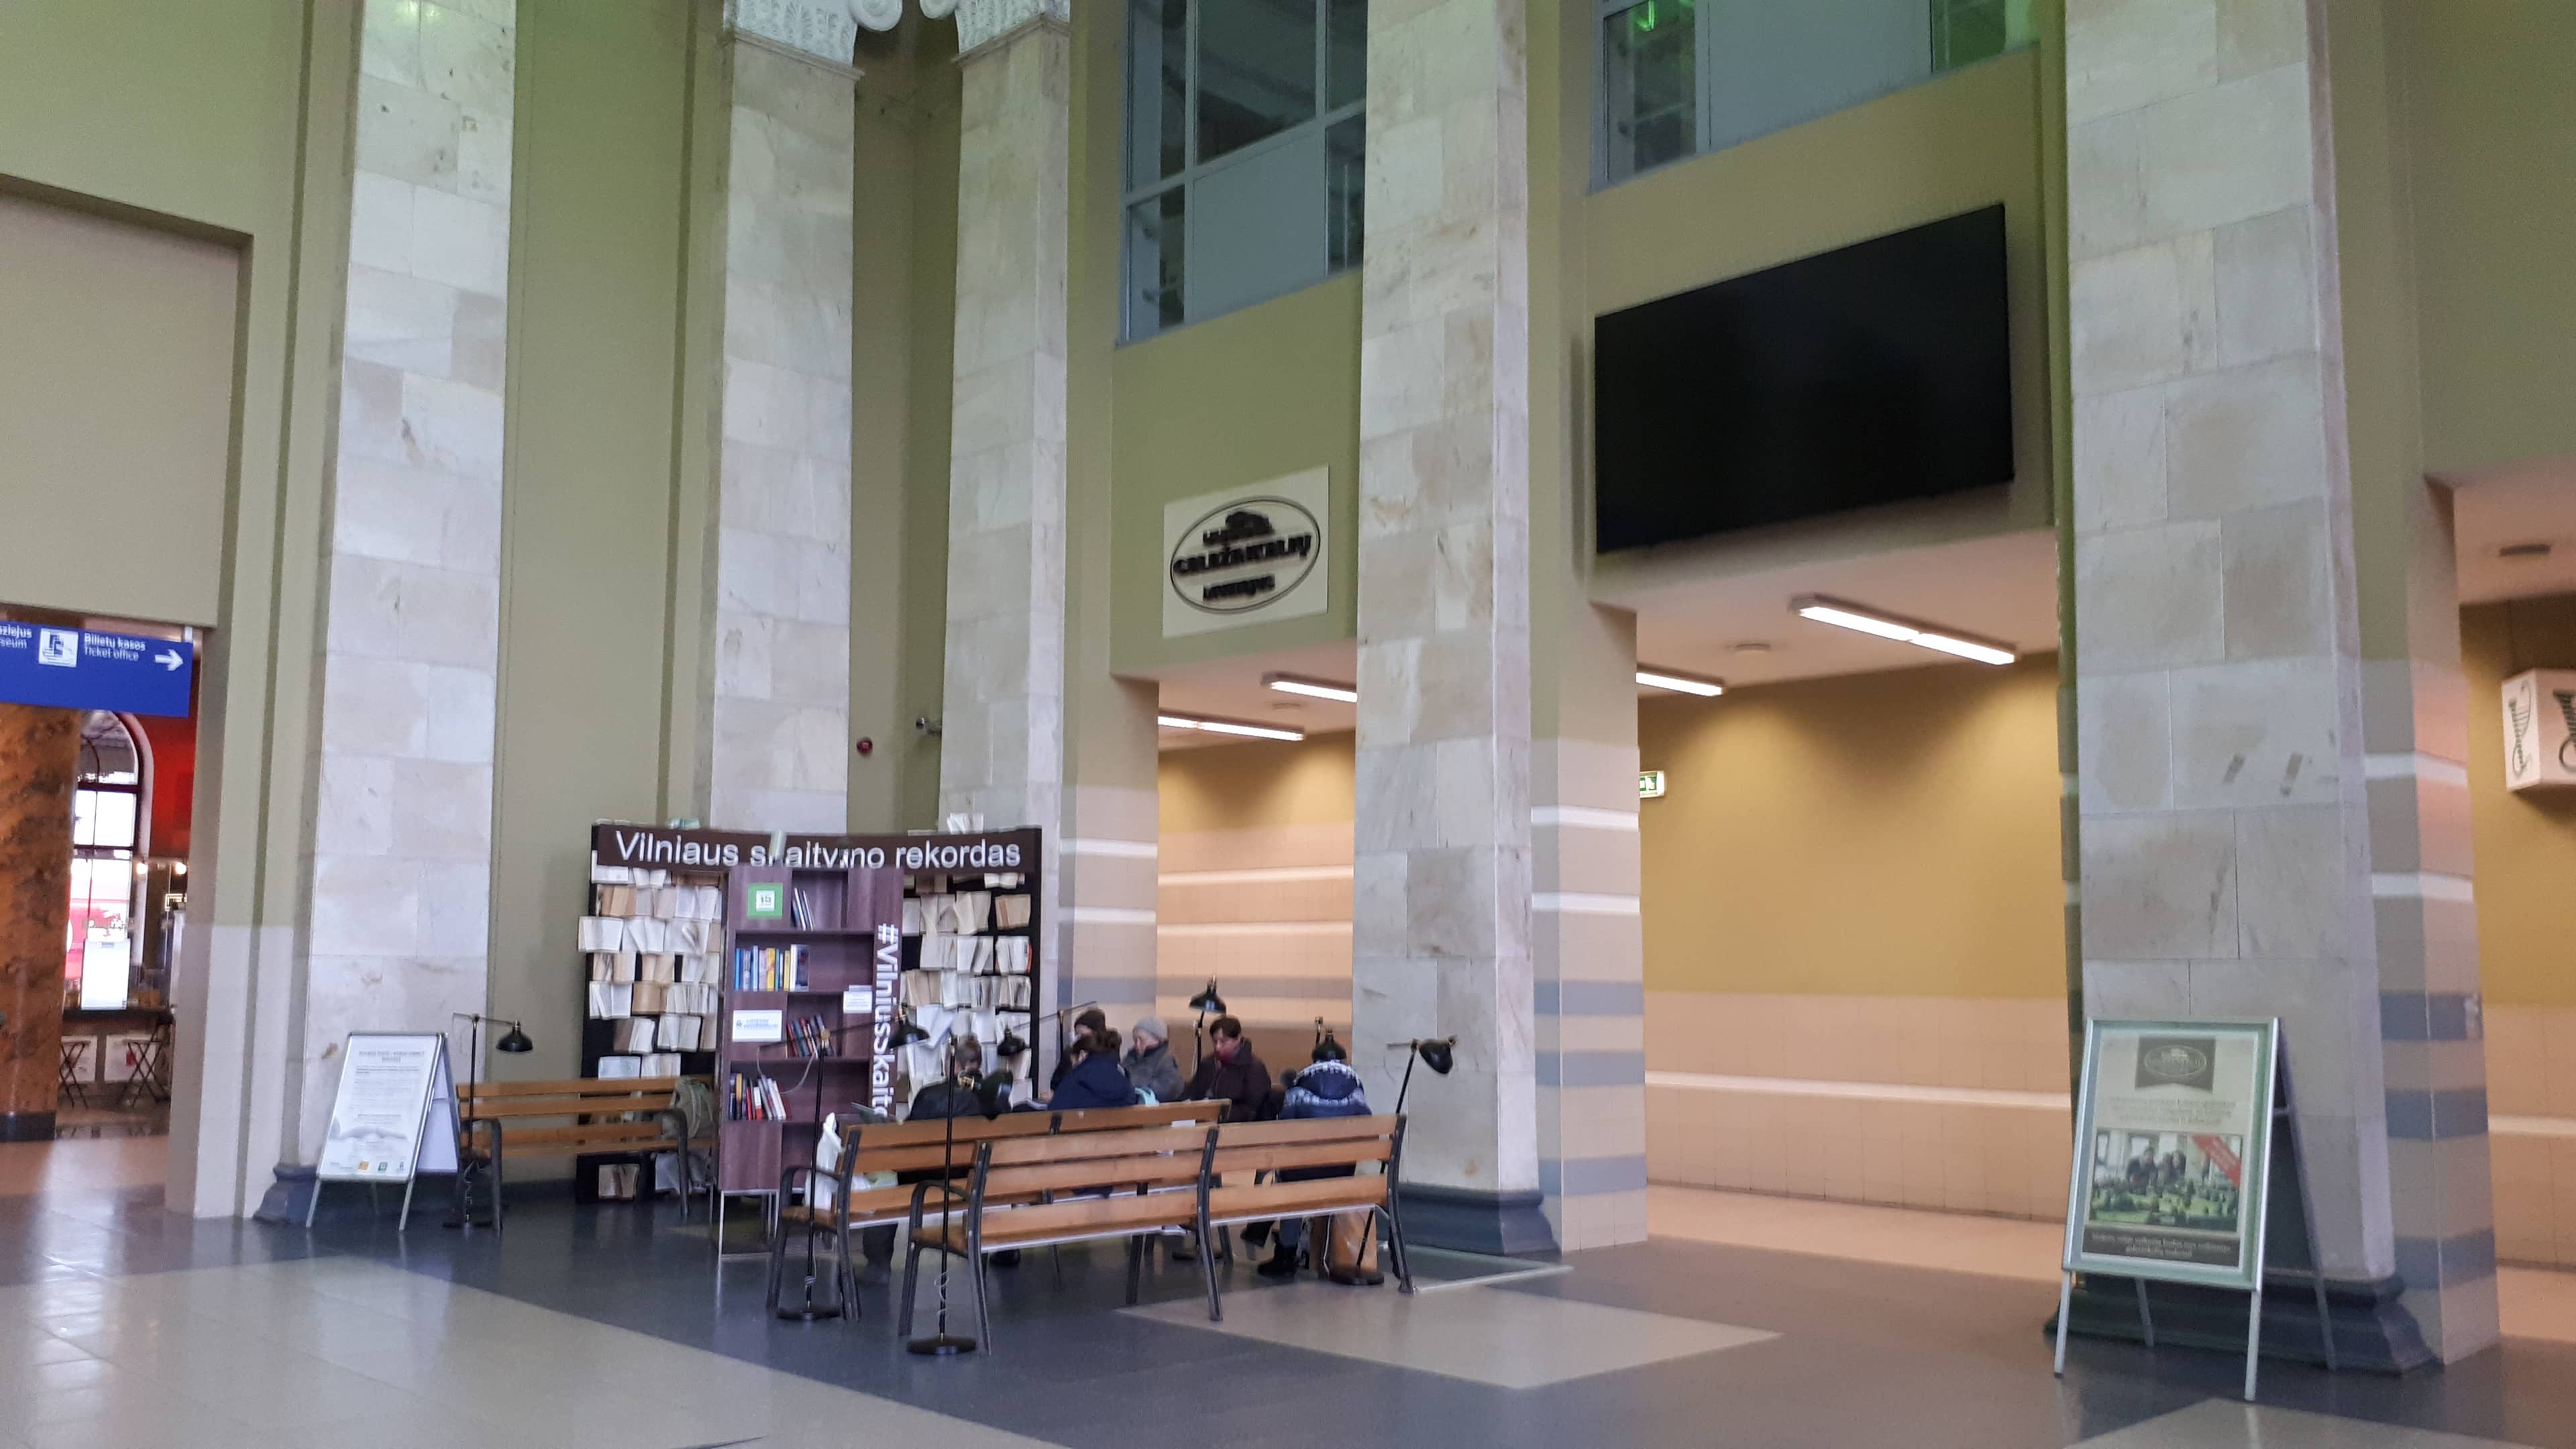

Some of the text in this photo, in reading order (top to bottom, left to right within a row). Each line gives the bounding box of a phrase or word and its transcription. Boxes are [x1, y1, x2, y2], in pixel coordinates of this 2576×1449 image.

[85, 646, 139, 662] Ticket office
[615, 830, 1021, 869] Vilniaus saitymo rekordas
